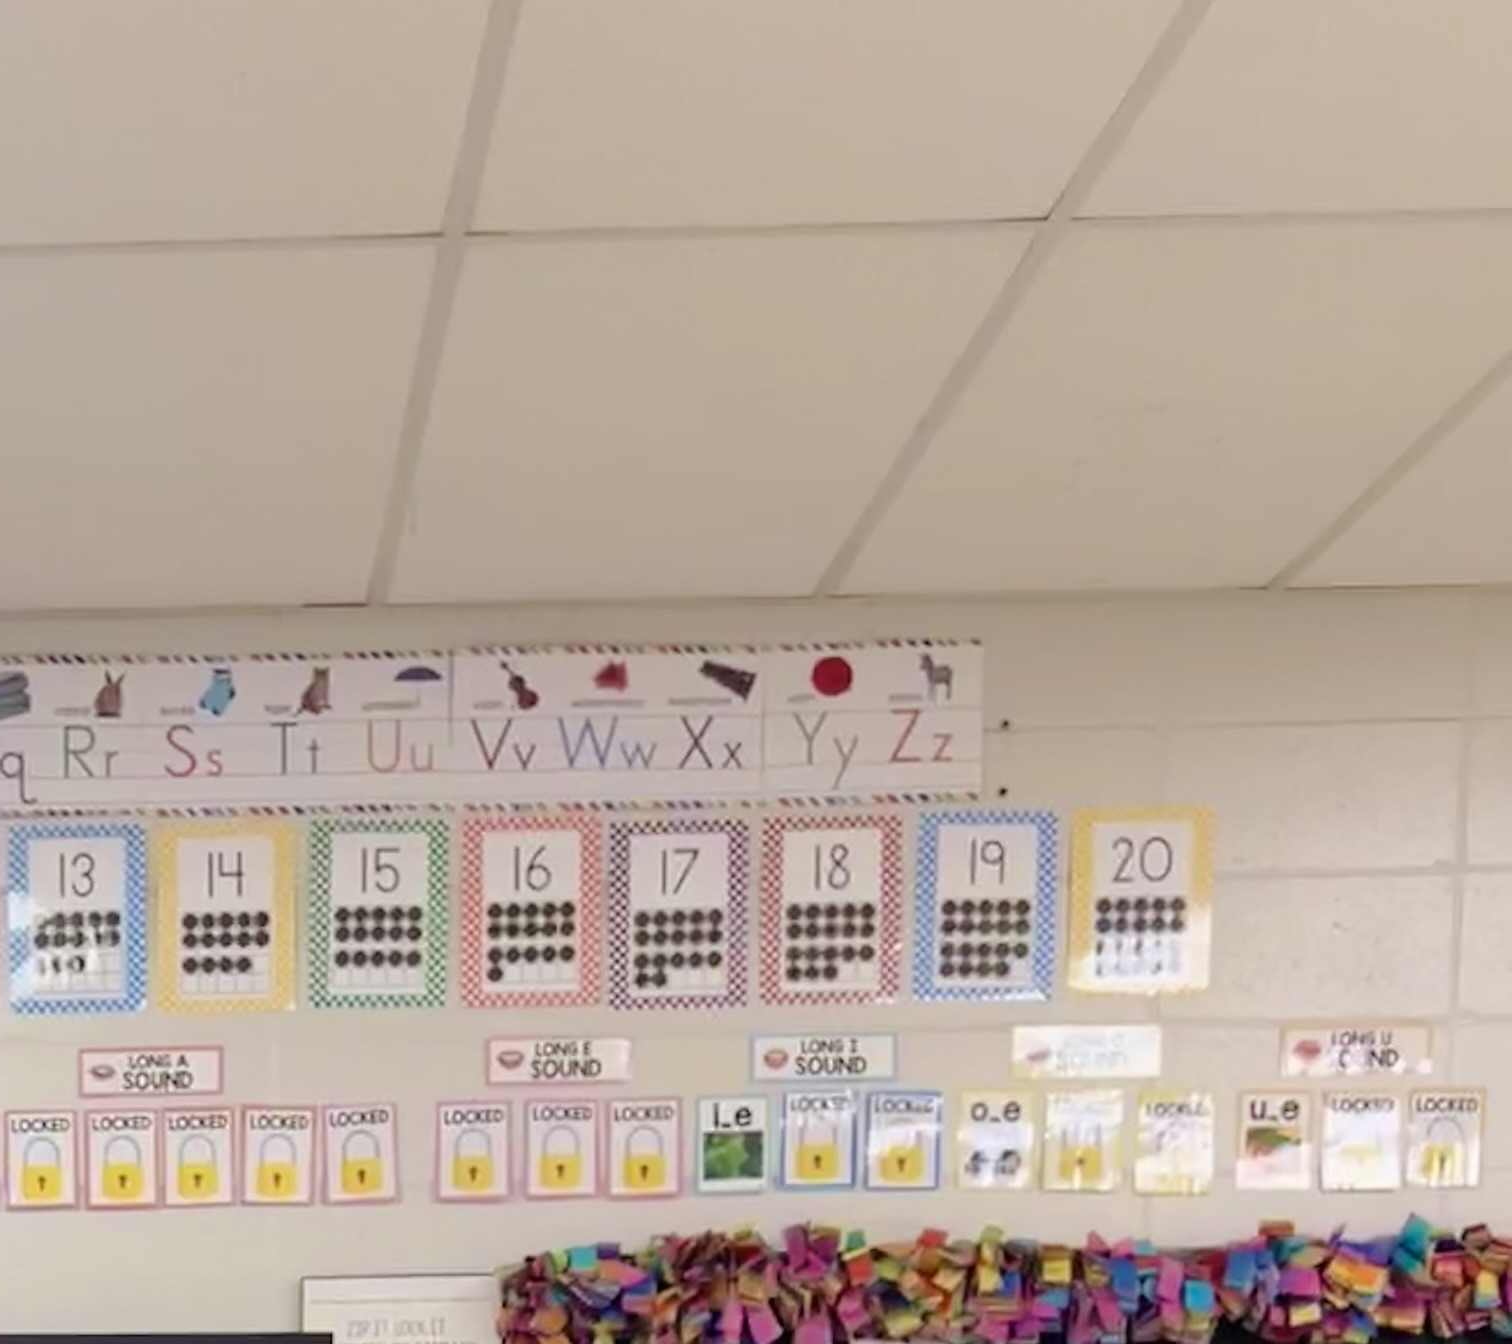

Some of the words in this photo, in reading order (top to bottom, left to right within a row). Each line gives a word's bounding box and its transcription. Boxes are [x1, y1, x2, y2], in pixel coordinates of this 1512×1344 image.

[63, 725, 119, 778] Rr
[164, 725, 224, 778] Ss
[367, 719, 434, 773] Uu
[471, 718, 535, 770] Vv
[558, 715, 657, 768] Ww
[678, 715, 743, 769] Xx
[792, 711, 859, 789] Yy
[889, 708, 954, 763] Zz
[360, 847, 401, 892] 15
[512, 845, 552, 891] 16
[813, 843, 851, 890] 18
[969, 837, 1006, 884] 19
[1111, 836, 1174, 883] 20
[58, 852, 96, 899] 13
[207, 851, 244, 898] 14
[660, 847, 701, 895] 17
[530, 1058, 603, 1078] SOUND
[794, 1056, 868, 1076] SOUND
[122, 1070, 195, 1092] SOUND
[91, 1115, 153, 1132] LOCKED
[168, 1114, 229, 1132] LOCKED
[249, 1114, 310, 1131] LOCKED
[328, 1110, 389, 1128] LOCKED
[443, 1107, 505, 1126] LOCKED
[531, 1105, 593, 1123] LOCKED
[613, 1105, 675, 1123] LOCKED
[10, 1117, 70, 1134] LOCKED
